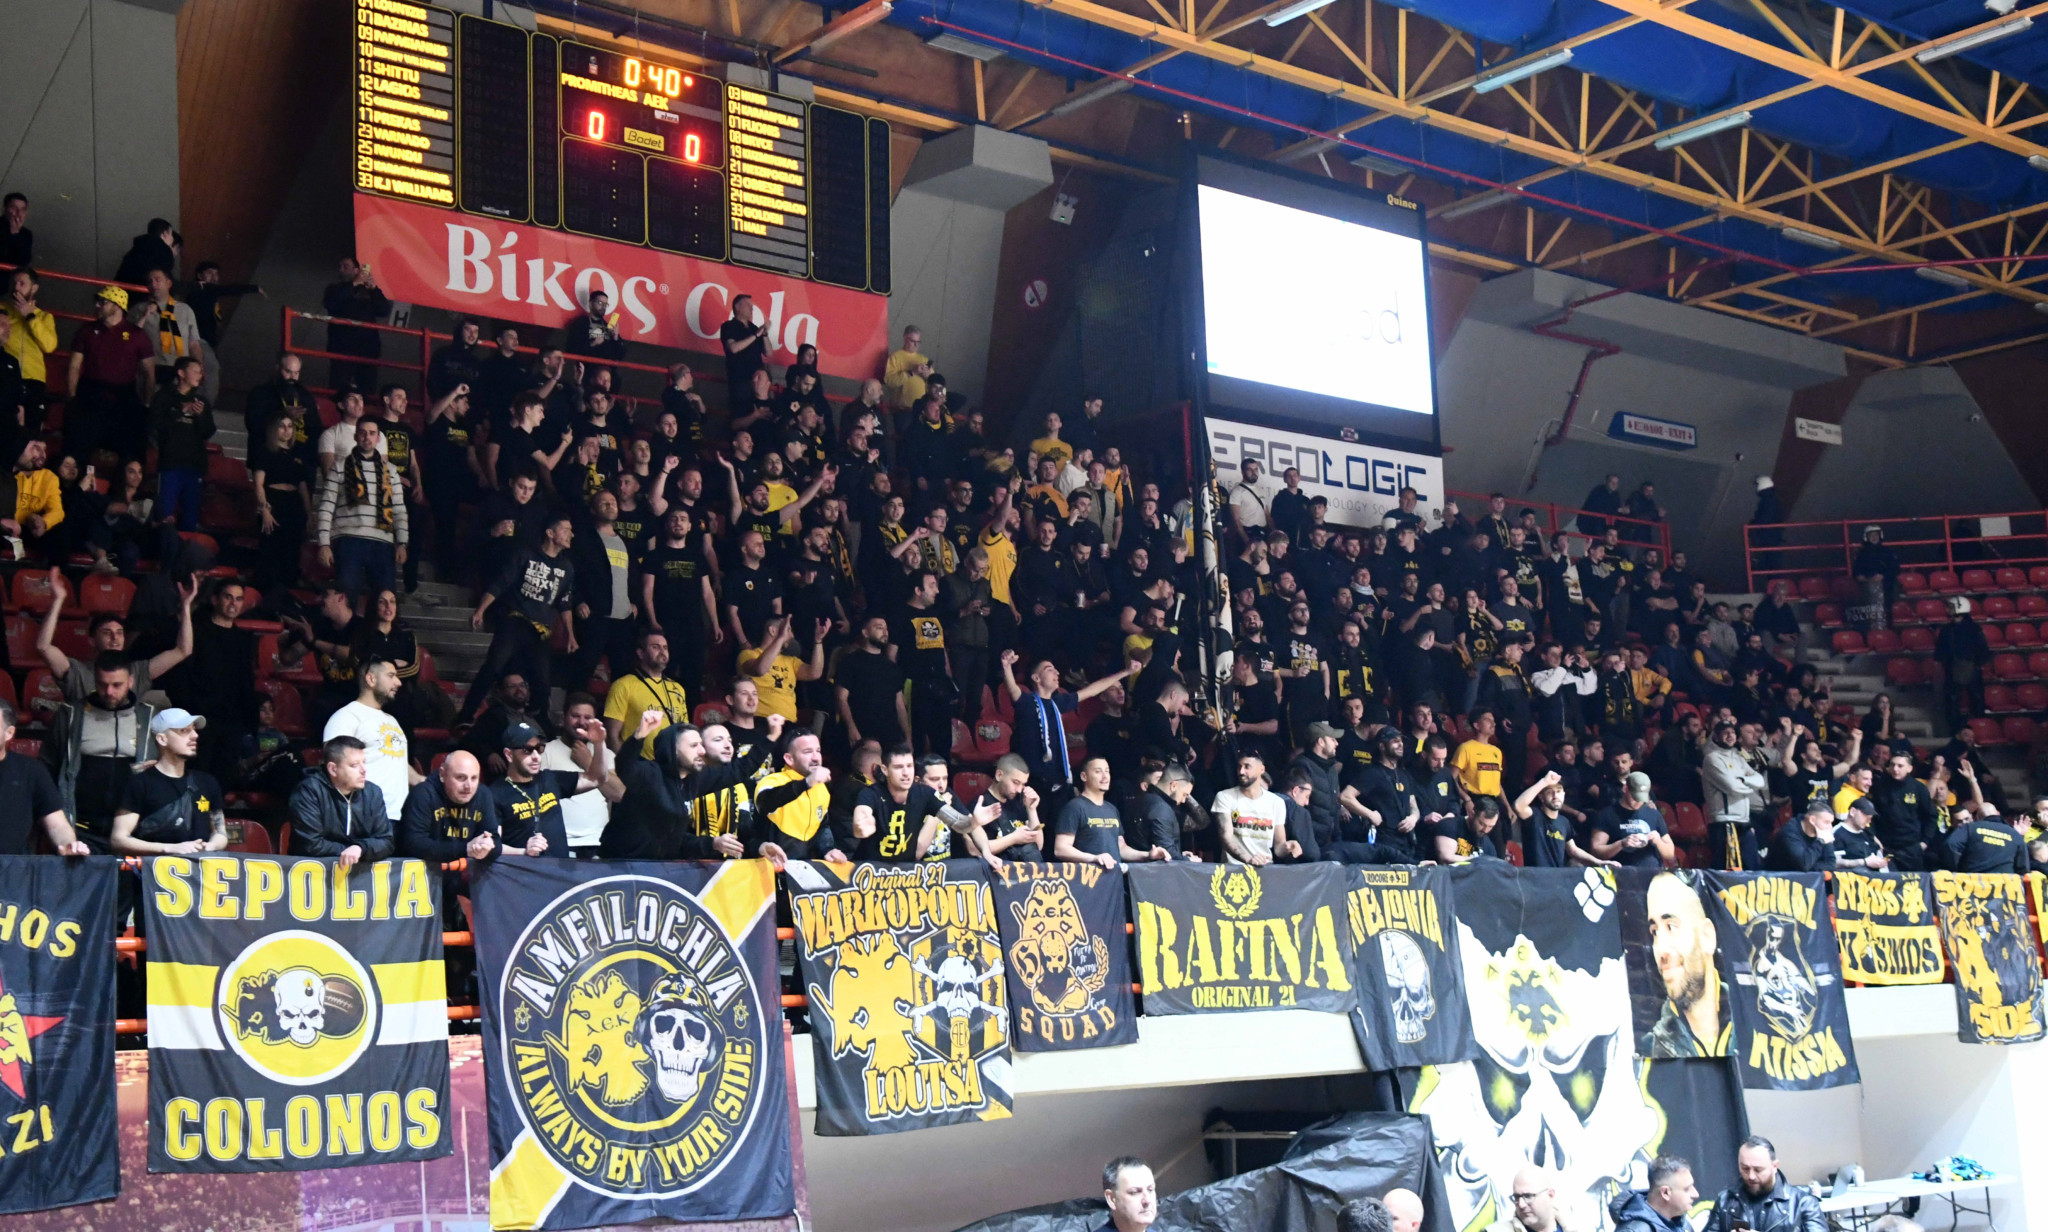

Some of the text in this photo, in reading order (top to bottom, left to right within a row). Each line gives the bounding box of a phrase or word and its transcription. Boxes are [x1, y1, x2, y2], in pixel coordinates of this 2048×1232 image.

[358, 9, 428, 37] 07 BAZINAS
[358, 25, 373, 41] 09
[359, 42, 373, 57] 10
[359, 58, 419, 83] 11 SHITTU
[359, 74, 373, 90] 12
[561, 72, 669, 110] PROMITHEAS AEK
[359, 90, 373, 106] 15
[728, 86, 740, 100] 03
[359, 107, 373, 122] 17
[728, 100, 741, 115] 04
[588, 110, 605, 141] 0
[729, 115, 741, 129] 07
[358, 122, 430, 149] 23 VARNADO
[627, 130, 662, 148] Bodet
[729, 129, 741, 144] 08
[358, 139, 373, 155] 25
[684, 133, 700, 163] 0
[730, 144, 742, 159] 19
[358, 155, 373, 171] 29
[730, 159, 741, 173] 21
[358, 172, 373, 188] 33
[730, 173, 742, 188] 23
[731, 188, 743, 203] 24
[1387, 193, 1418, 211] Quince
[731, 202, 743, 217] 33
[856, 865, 944, 897] Original 21
[998, 862, 1103, 889] YELLOW
[152, 856, 435, 920] SEPOLIA
[1932, 870, 2026, 904] SOUTH
[510, 892, 747, 1017] AMFILOCHIA
[1138, 901, 1352, 996] RAFINA
[1191, 984, 1297, 1008] ORIGINAL 21
[1020, 1006, 1116, 1043] SQUAD
[865, 1058, 983, 1116] LOUTSA
[512, 1040, 753, 1185] ALWAYS BY YOUR SIDE
[0, 1104, 53, 1159] ZI
[165, 1087, 441, 1161] COLONOS
